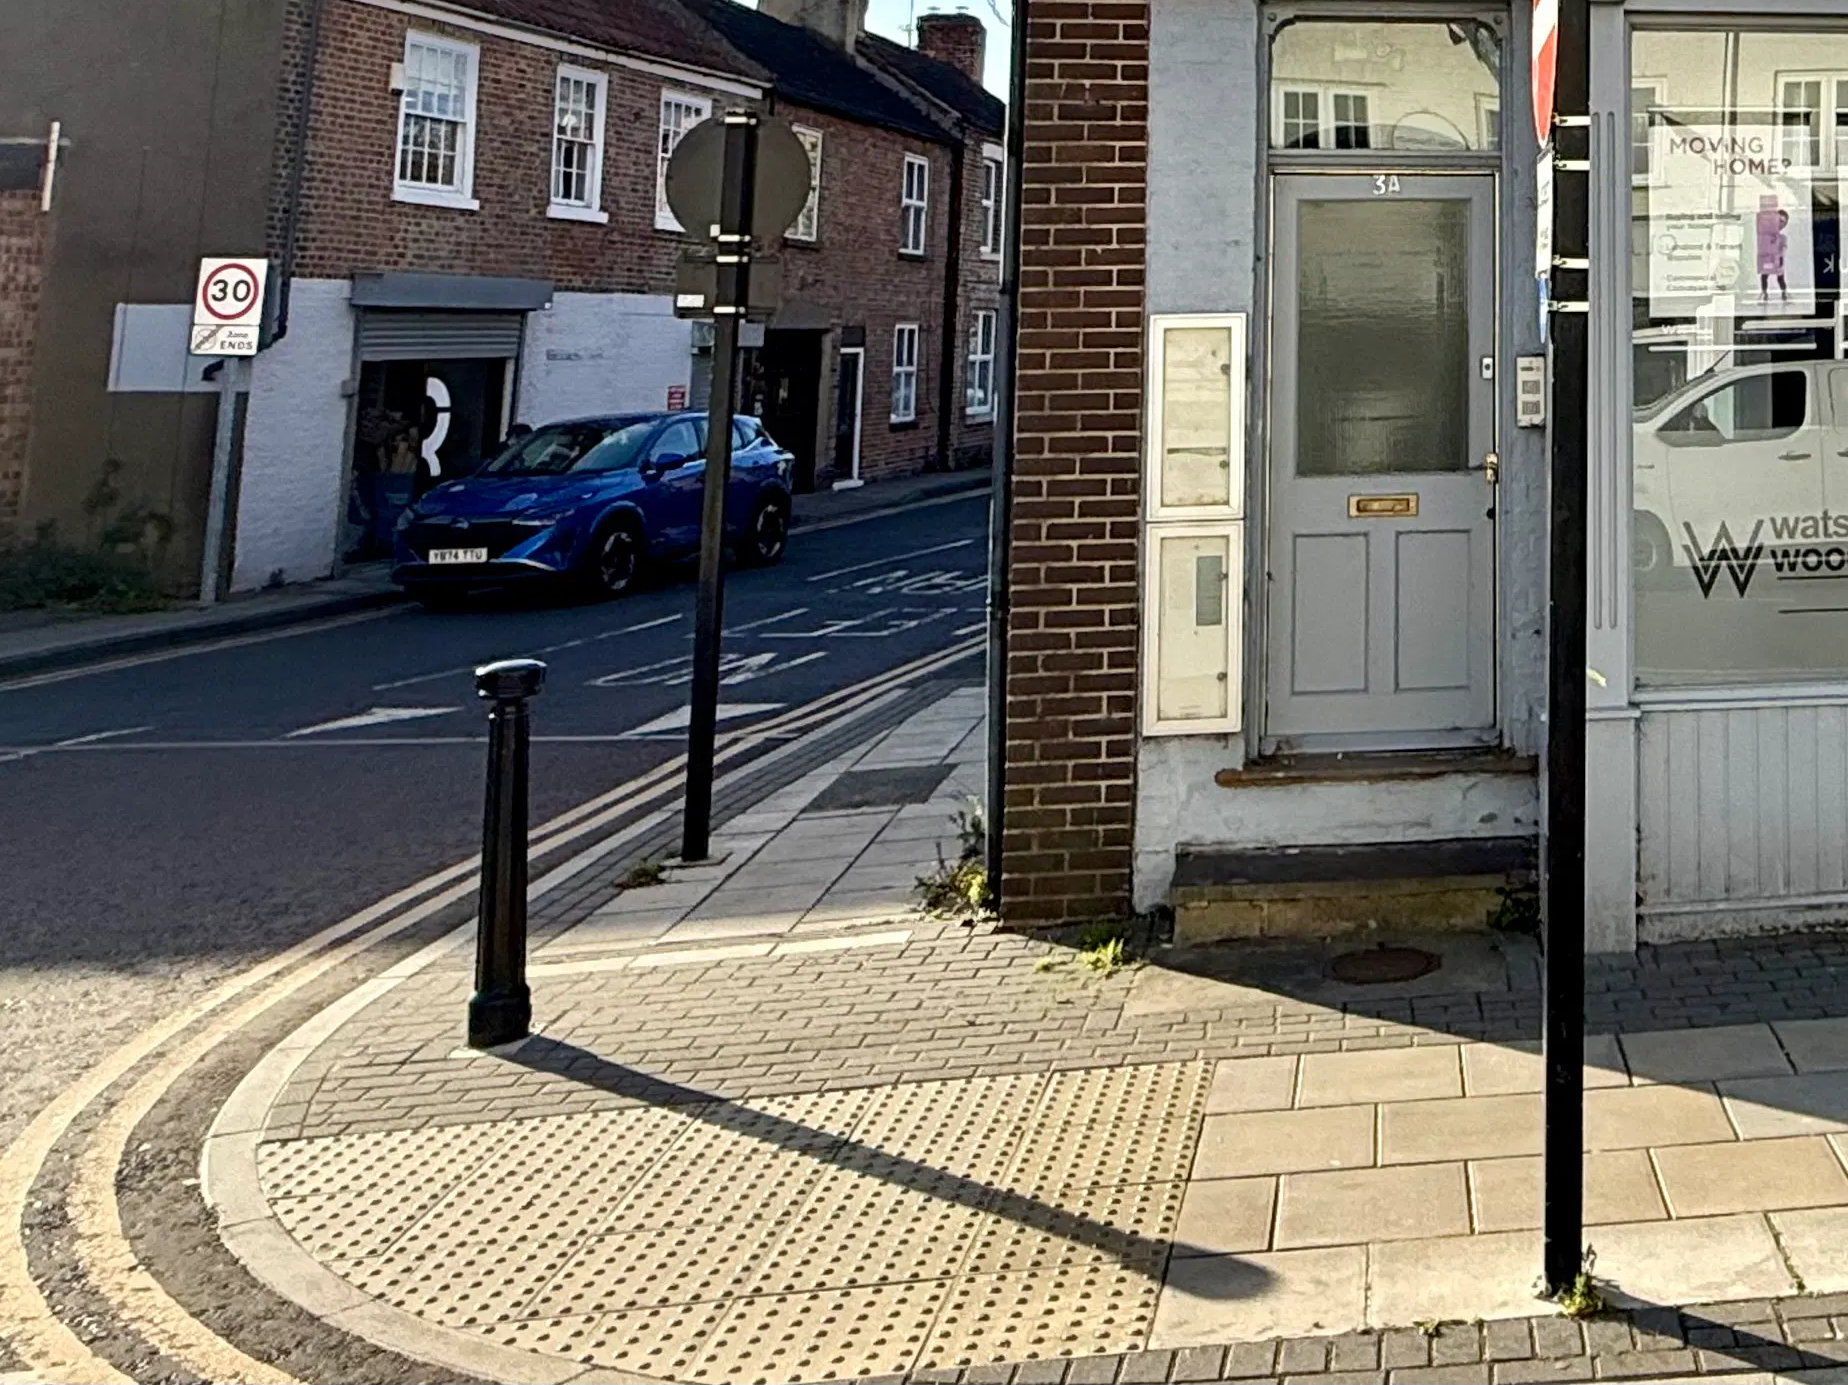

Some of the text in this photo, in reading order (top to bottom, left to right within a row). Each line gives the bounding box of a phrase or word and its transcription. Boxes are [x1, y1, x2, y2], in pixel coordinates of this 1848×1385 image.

[1669, 136, 1764, 154] MOVING
[1713, 157, 1793, 175] HOME?
[1372, 174, 1401, 196] 3A
[211, 279, 251, 302] 30
[219, 340, 253, 350] ENDS
